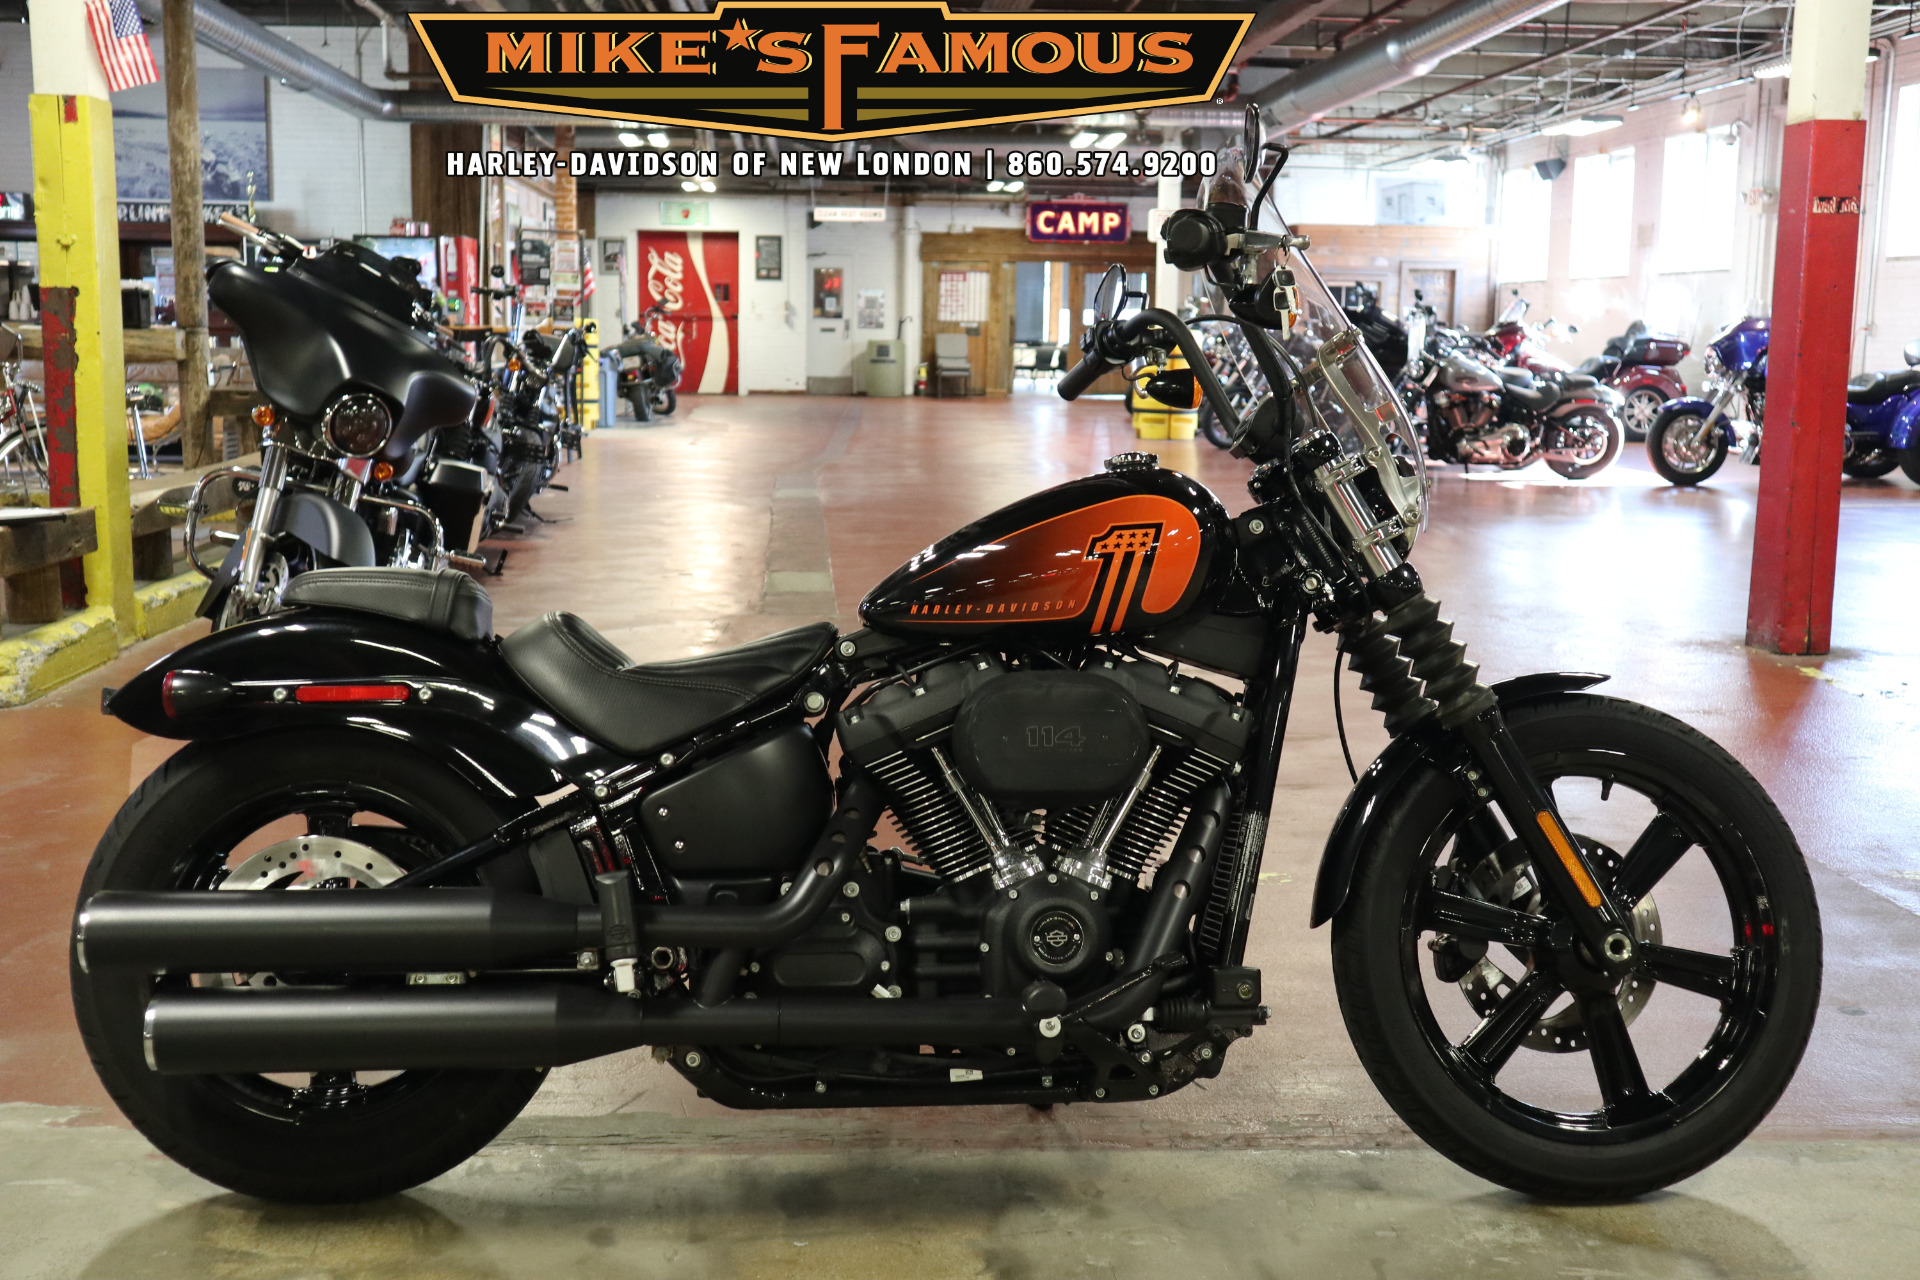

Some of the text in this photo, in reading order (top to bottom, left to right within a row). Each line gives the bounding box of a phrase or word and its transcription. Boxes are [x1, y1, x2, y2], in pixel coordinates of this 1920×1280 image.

[1036, 210, 1122, 235] CAMP
[910, 600, 1076, 615] HARLEY-DAVIDSON
[1026, 725, 1087, 747] 114
